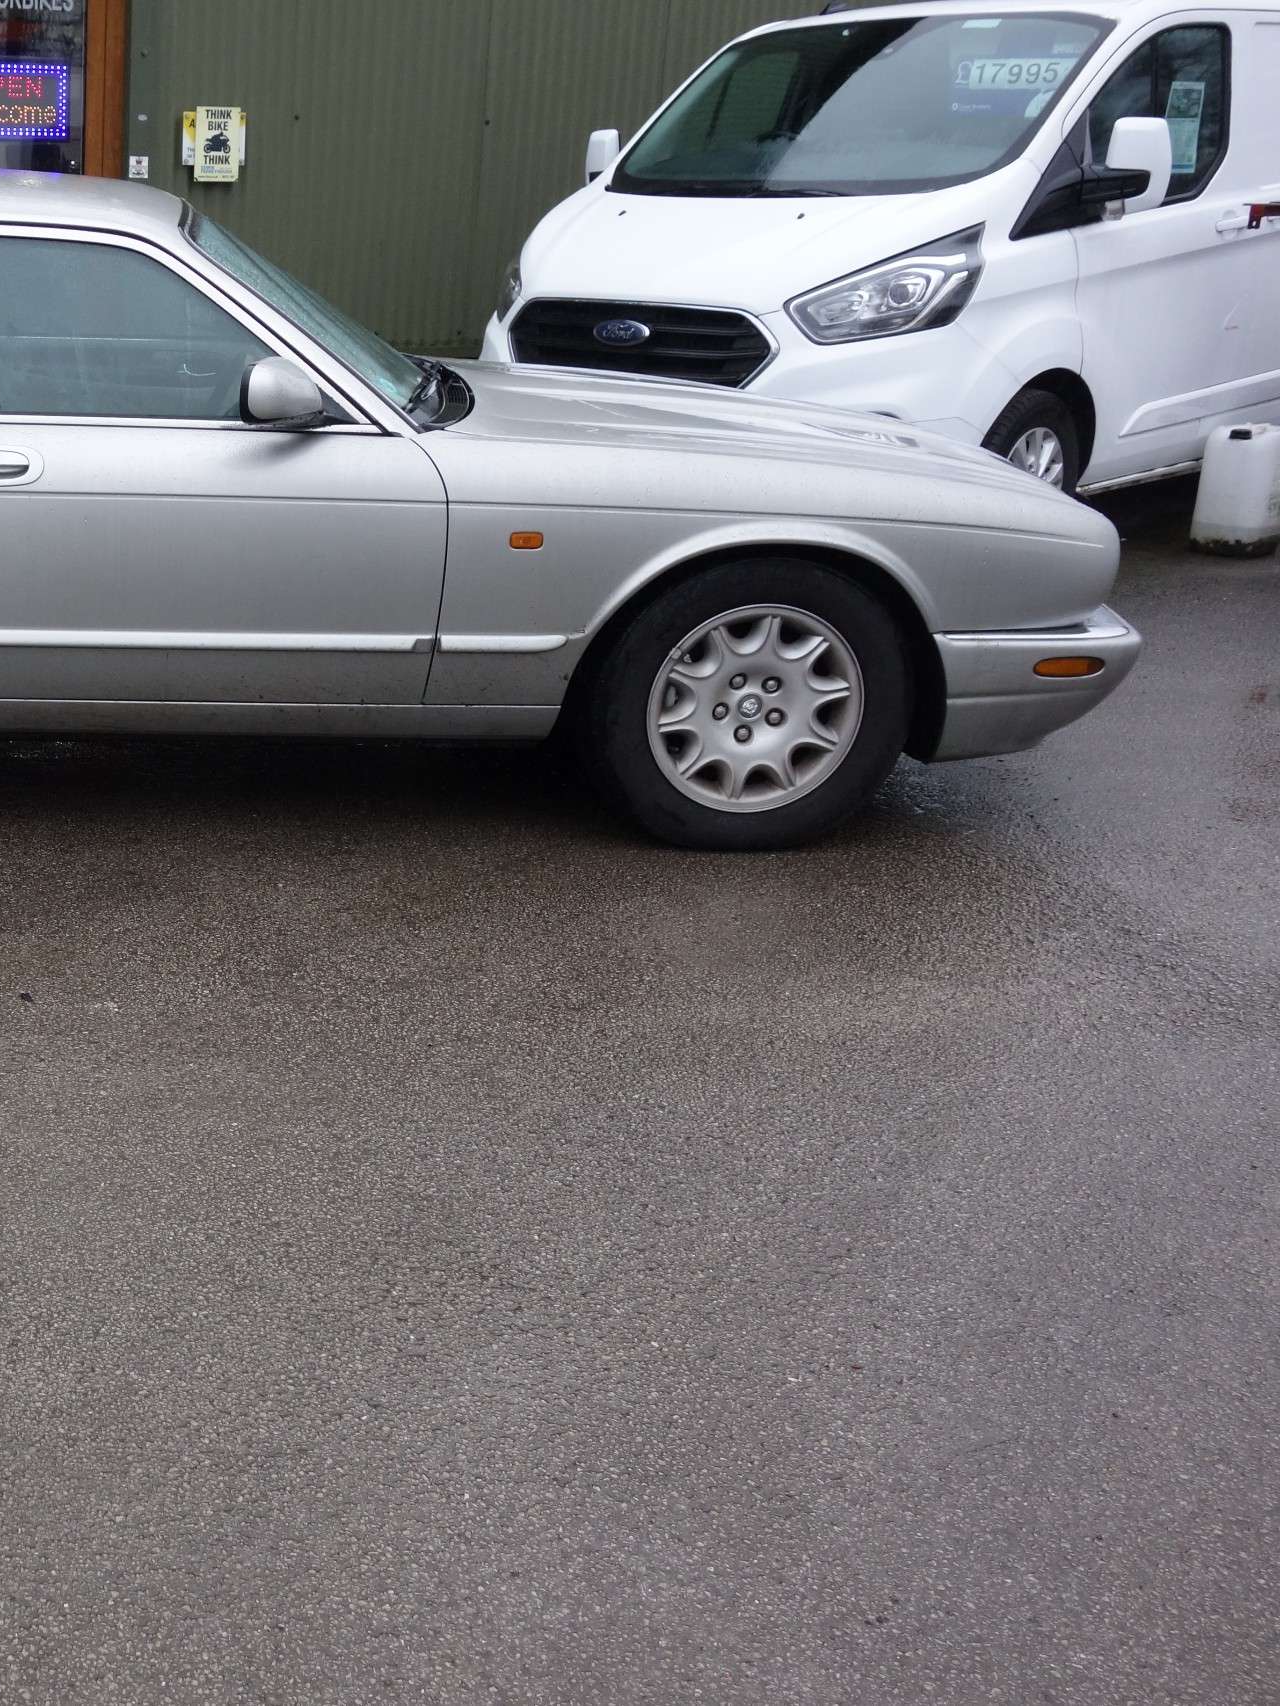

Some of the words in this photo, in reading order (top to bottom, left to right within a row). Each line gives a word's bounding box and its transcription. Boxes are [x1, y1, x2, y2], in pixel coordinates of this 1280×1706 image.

[205, 109, 232, 120] THINK
[207, 121, 228, 131] BIKE
[204, 155, 230, 165] THINK
